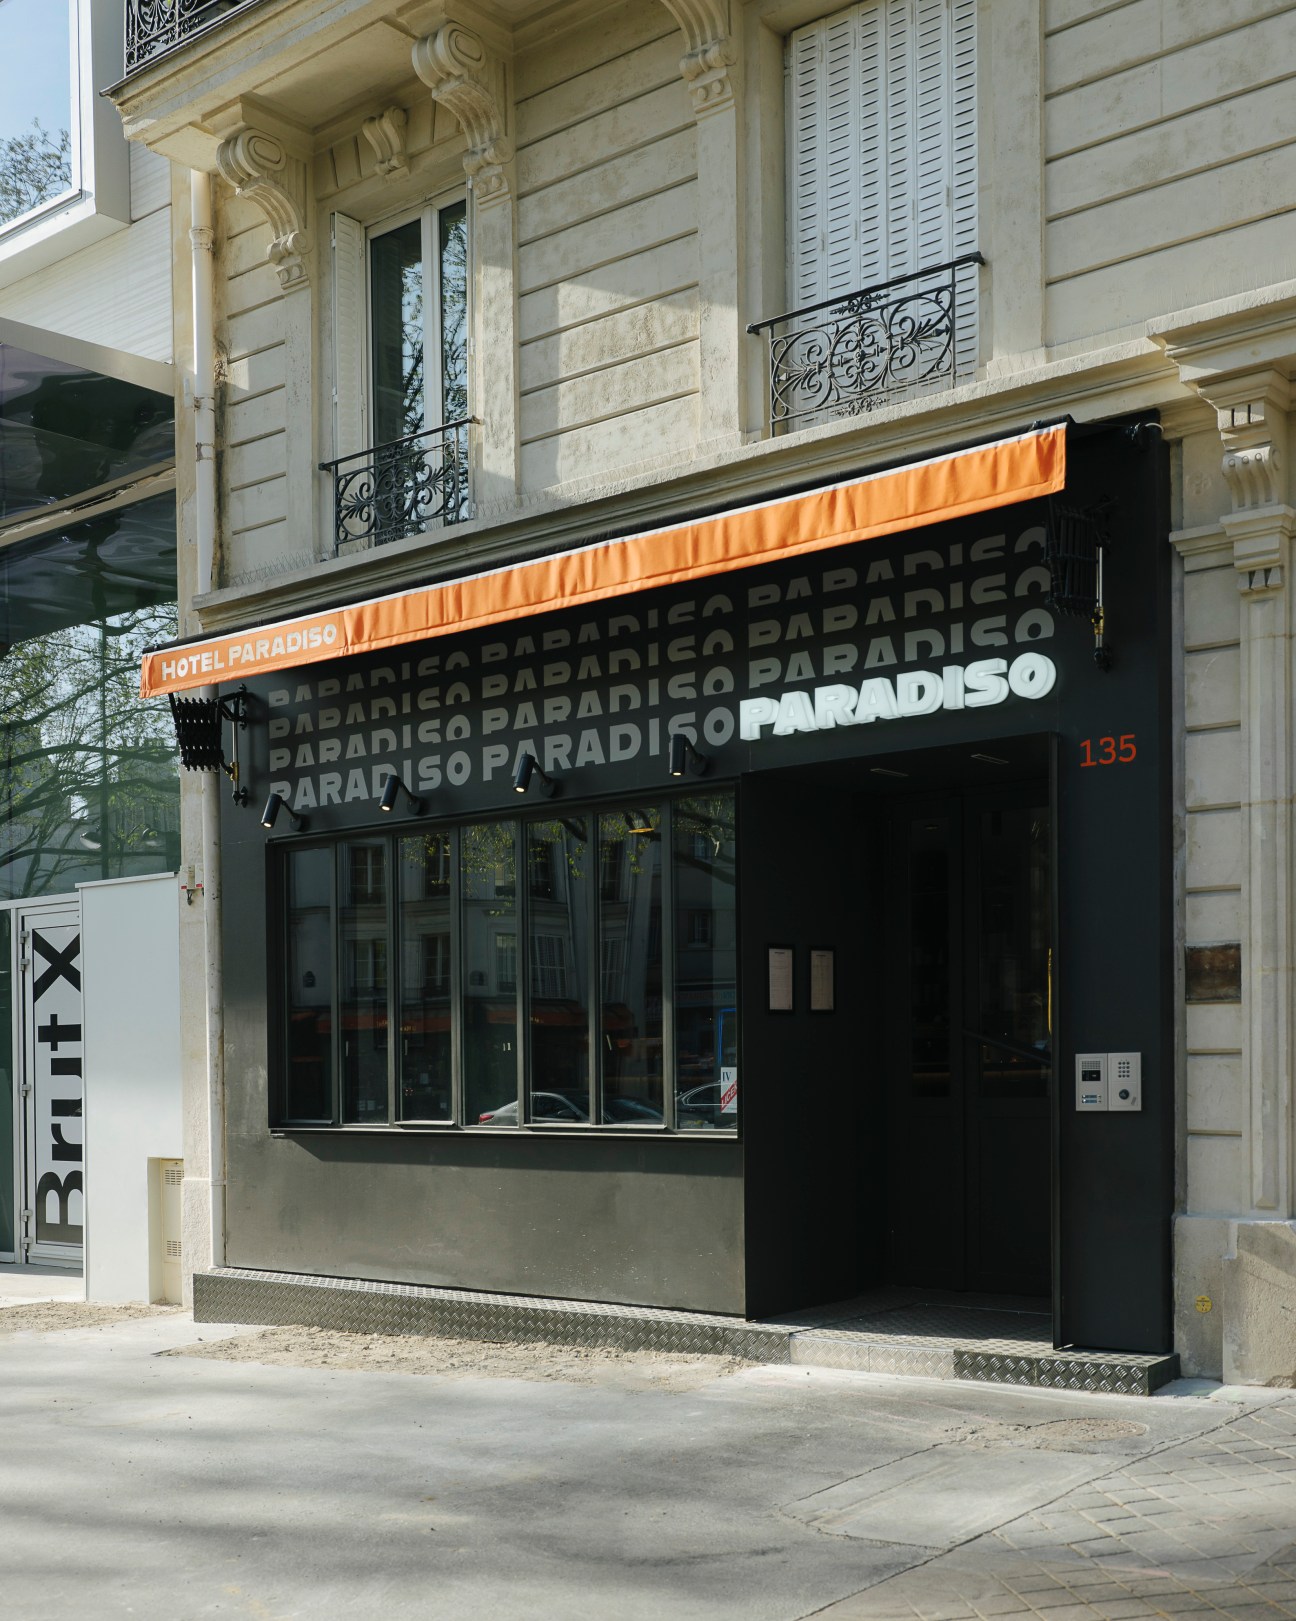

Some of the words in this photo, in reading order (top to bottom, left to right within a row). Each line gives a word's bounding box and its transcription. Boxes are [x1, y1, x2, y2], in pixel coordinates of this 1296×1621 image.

[161, 651, 224, 681] HOTEL
[228, 623, 337, 667] PARADISO
[269, 714, 471, 772] PARADISO
[482, 666, 735, 735] PARADISO
[748, 608, 1055, 689] PARADISO
[269, 751, 472, 811] PARADISO
[482, 706, 735, 782] PARADISO
[740, 652, 1057, 741] PARADISO
[1079, 734, 1138, 768] 135
[722, 1071, 732, 1082] IV
